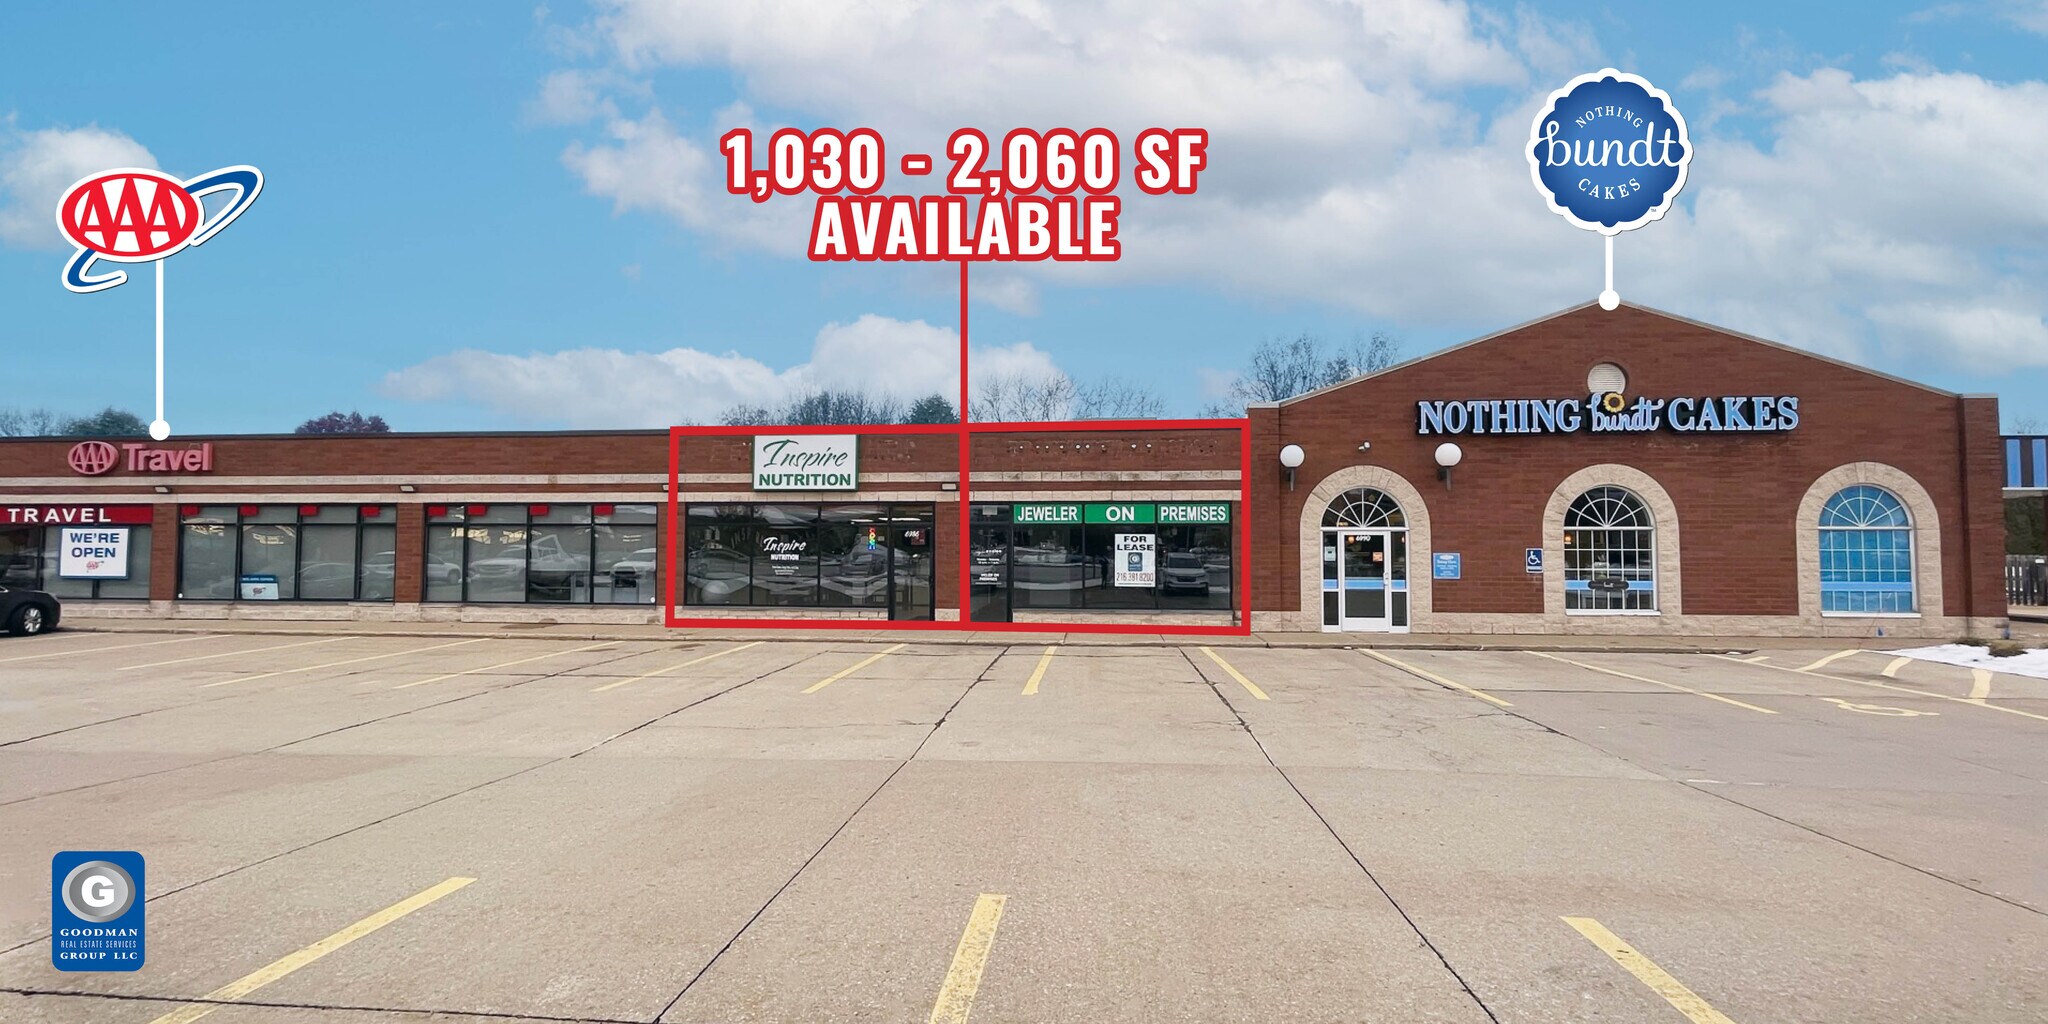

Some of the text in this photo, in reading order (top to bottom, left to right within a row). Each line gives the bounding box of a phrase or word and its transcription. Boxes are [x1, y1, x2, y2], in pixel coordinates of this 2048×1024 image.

[1417, 394, 1799, 434] NOTHING bundt CAKES
[70, 442, 214, 474] AAA Travel
[762, 438, 848, 471] Inspire
[758, 473, 851, 486] NUTRITION
[7, 508, 112, 523] TRAVEL
[1017, 506, 1226, 521] JEWELER ON PREMISES
[70, 532, 120, 543] WE'RE
[763, 536, 807, 554] Inspire
[1123, 535, 1147, 543] FOR
[71, 547, 116, 558] OPEN
